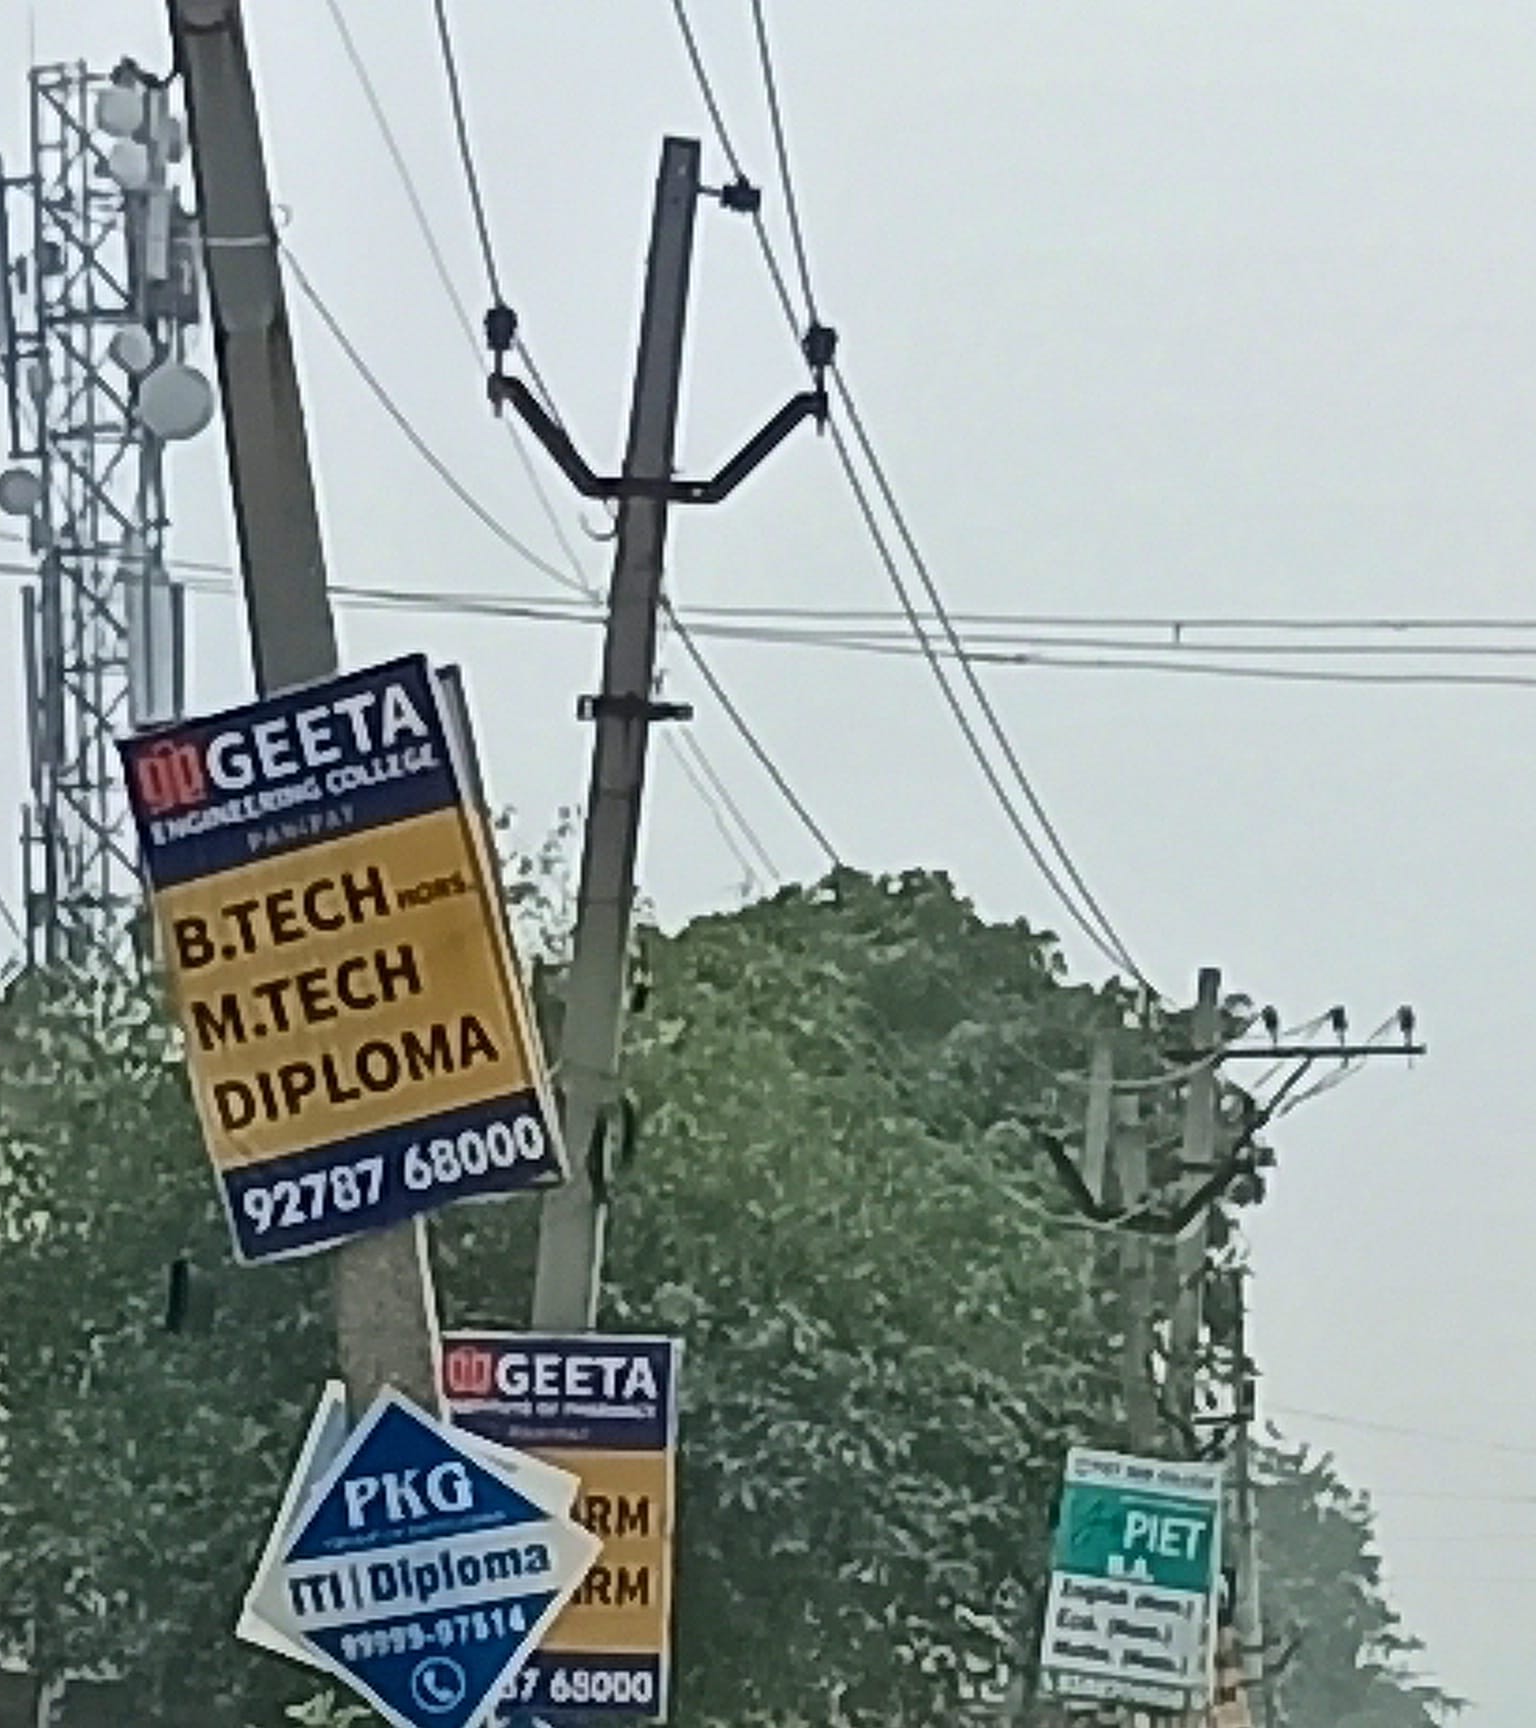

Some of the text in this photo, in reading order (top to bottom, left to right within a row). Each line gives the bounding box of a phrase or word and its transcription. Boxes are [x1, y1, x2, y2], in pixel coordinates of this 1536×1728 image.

[205, 684, 429, 791] GEETA
[325, 742, 441, 796] COLLEGE
[173, 866, 392, 970] B.TECH
[191, 943, 423, 1052] M.TECH
[212, 1014, 501, 1132] DIPLOMA
[242, 1114, 546, 1235] 92787 68000
[495, 1353, 658, 1399] GEETA
[344, 1461, 475, 1529] PKG
[1123, 1510, 1207, 1560] PIET
[368, 1543, 552, 1604] Diploma
